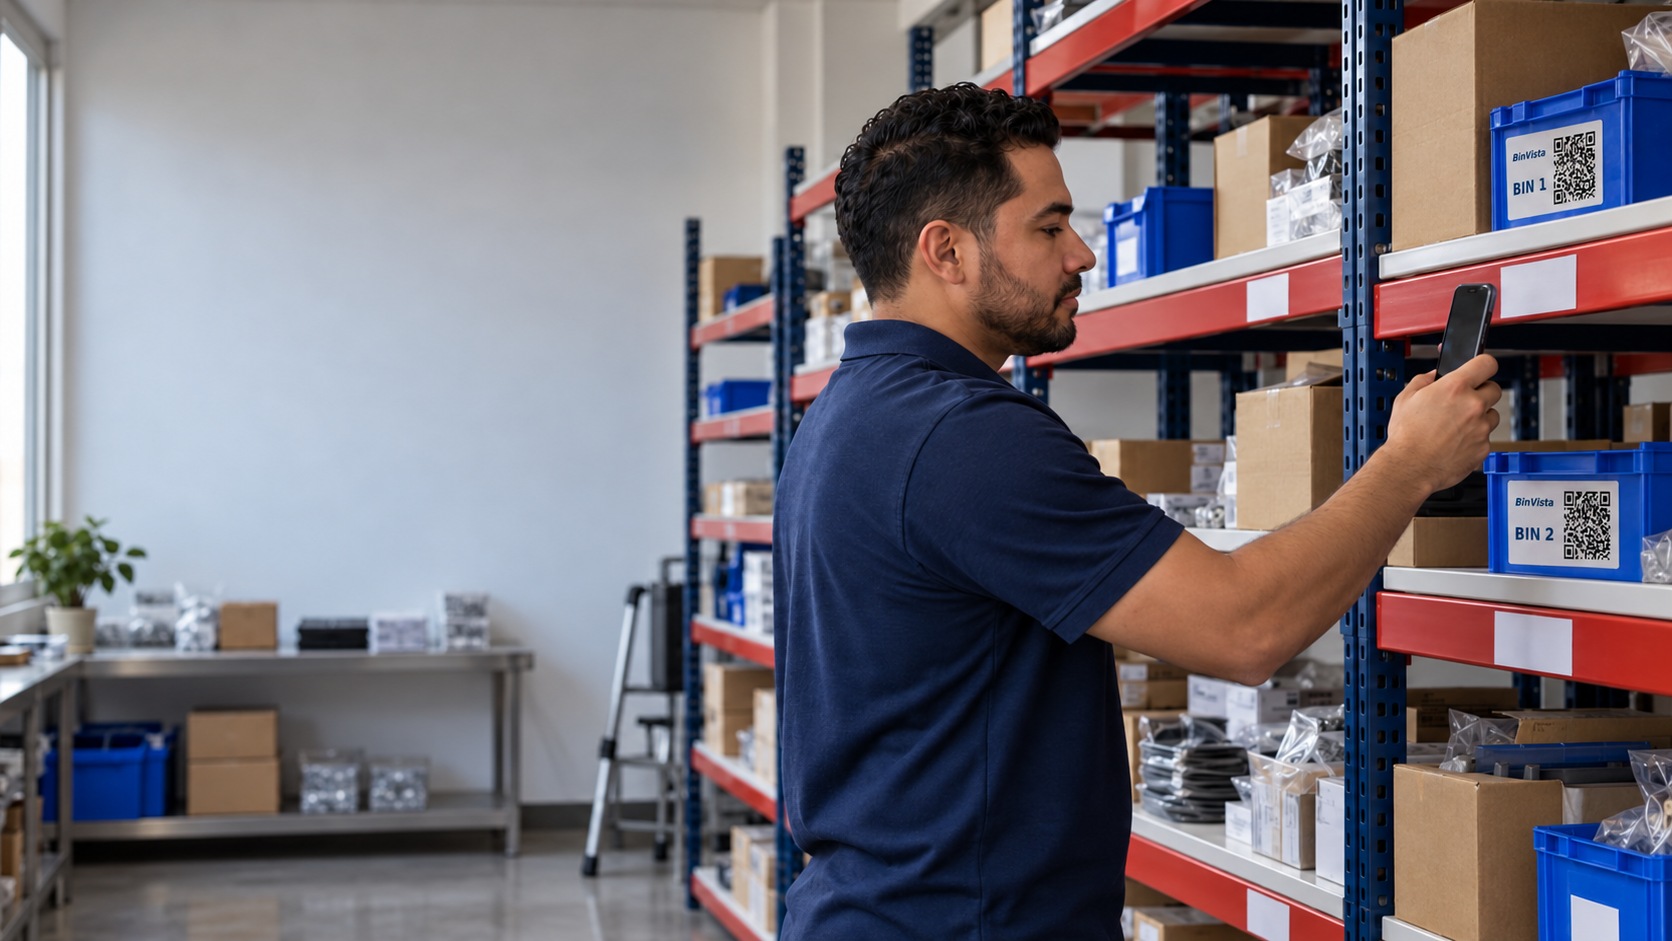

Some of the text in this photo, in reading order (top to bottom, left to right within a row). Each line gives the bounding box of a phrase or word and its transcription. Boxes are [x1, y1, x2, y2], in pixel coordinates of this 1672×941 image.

[1512, 149, 1546, 162] BinVista
[1513, 177, 1547, 196] BIN 1
[1515, 497, 1554, 507] BinVista
[1515, 527, 1554, 541] BIN 2
